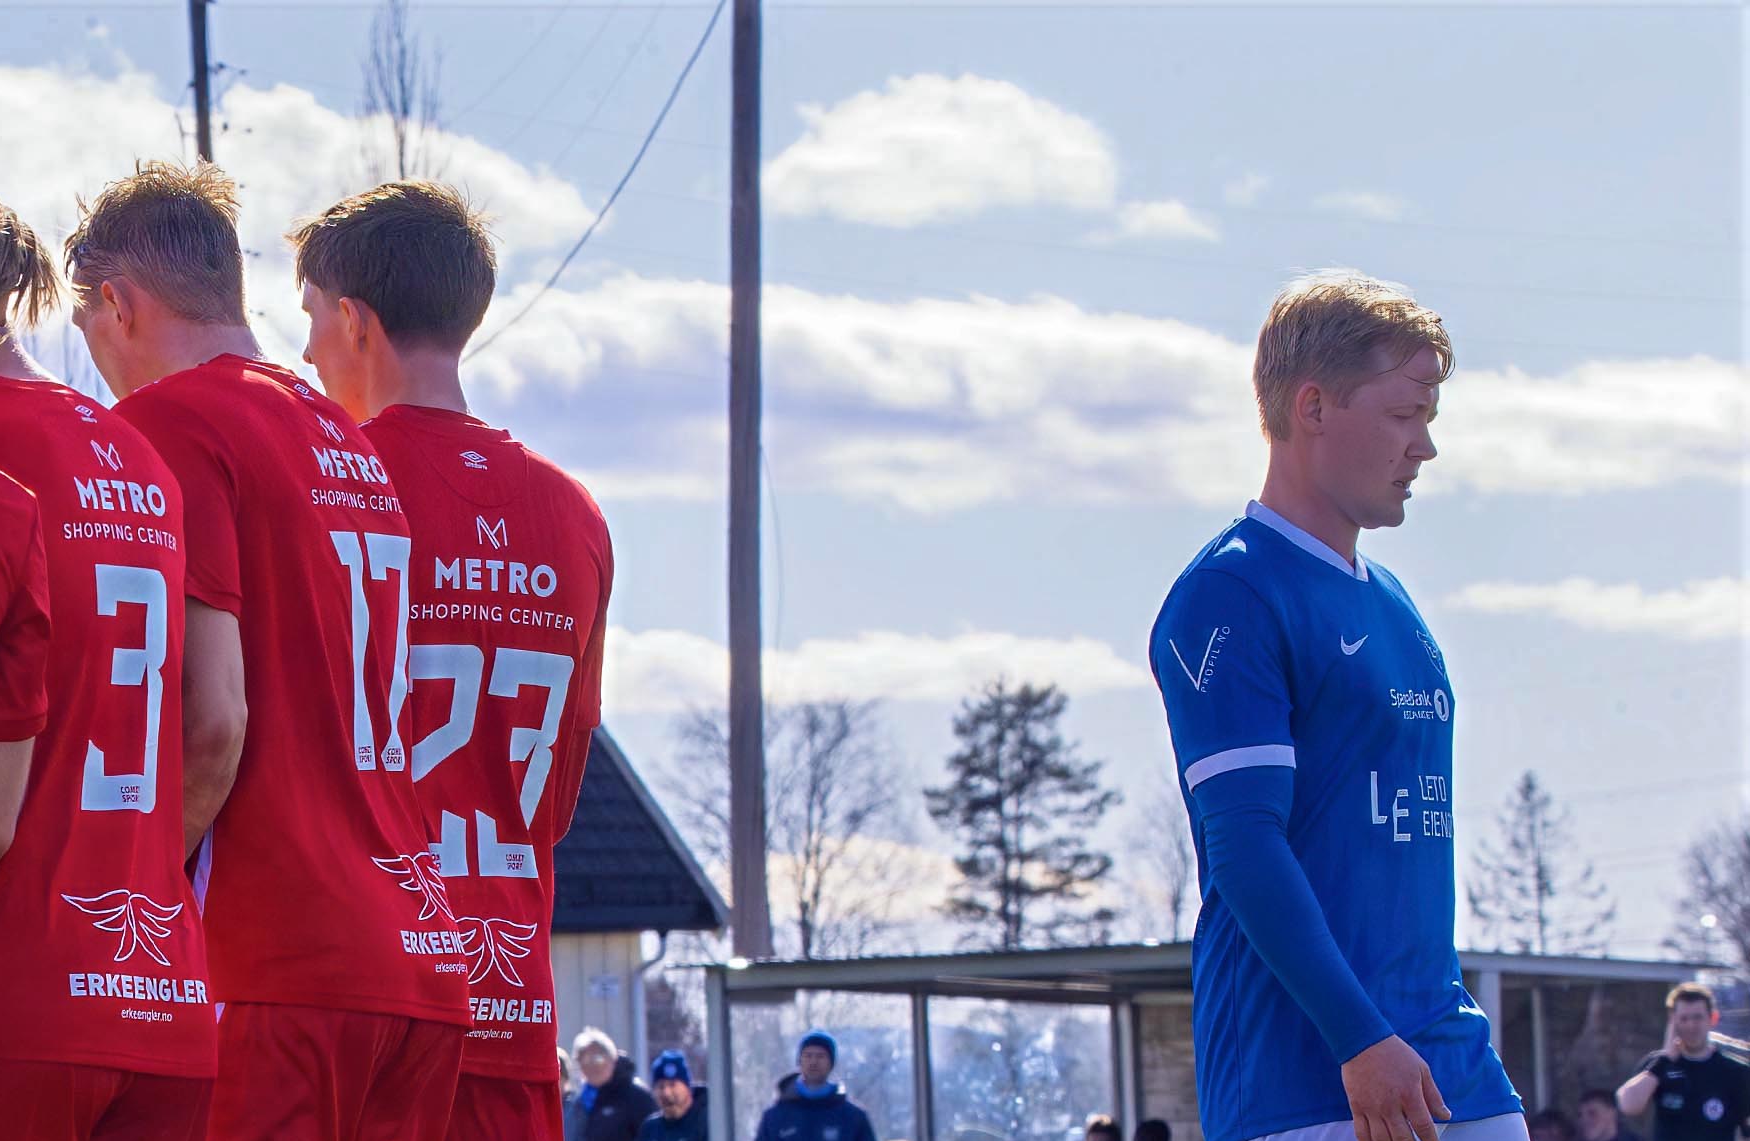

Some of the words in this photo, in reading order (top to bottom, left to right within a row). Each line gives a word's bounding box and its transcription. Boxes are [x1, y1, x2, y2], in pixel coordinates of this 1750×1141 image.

[311, 446, 388, 484] METRO
[73, 476, 166, 517] METRO
[311, 488, 366, 509] SHOPPING
[63, 522, 133, 542] SHOPPING
[137, 527, 177, 551] CENTER
[434, 556, 557, 597] METRO
[410, 603, 503, 622] SHOPPING
[509, 608, 574, 631] CENTER
[329, 531, 411, 771] 17
[81, 564, 166, 813] 3
[408, 644, 574, 878] 23
[1418, 775, 1447, 802] LETO
[69, 973, 209, 1004] ERKEENGLER
[121, 1008, 173, 1022] erkeengler.no
